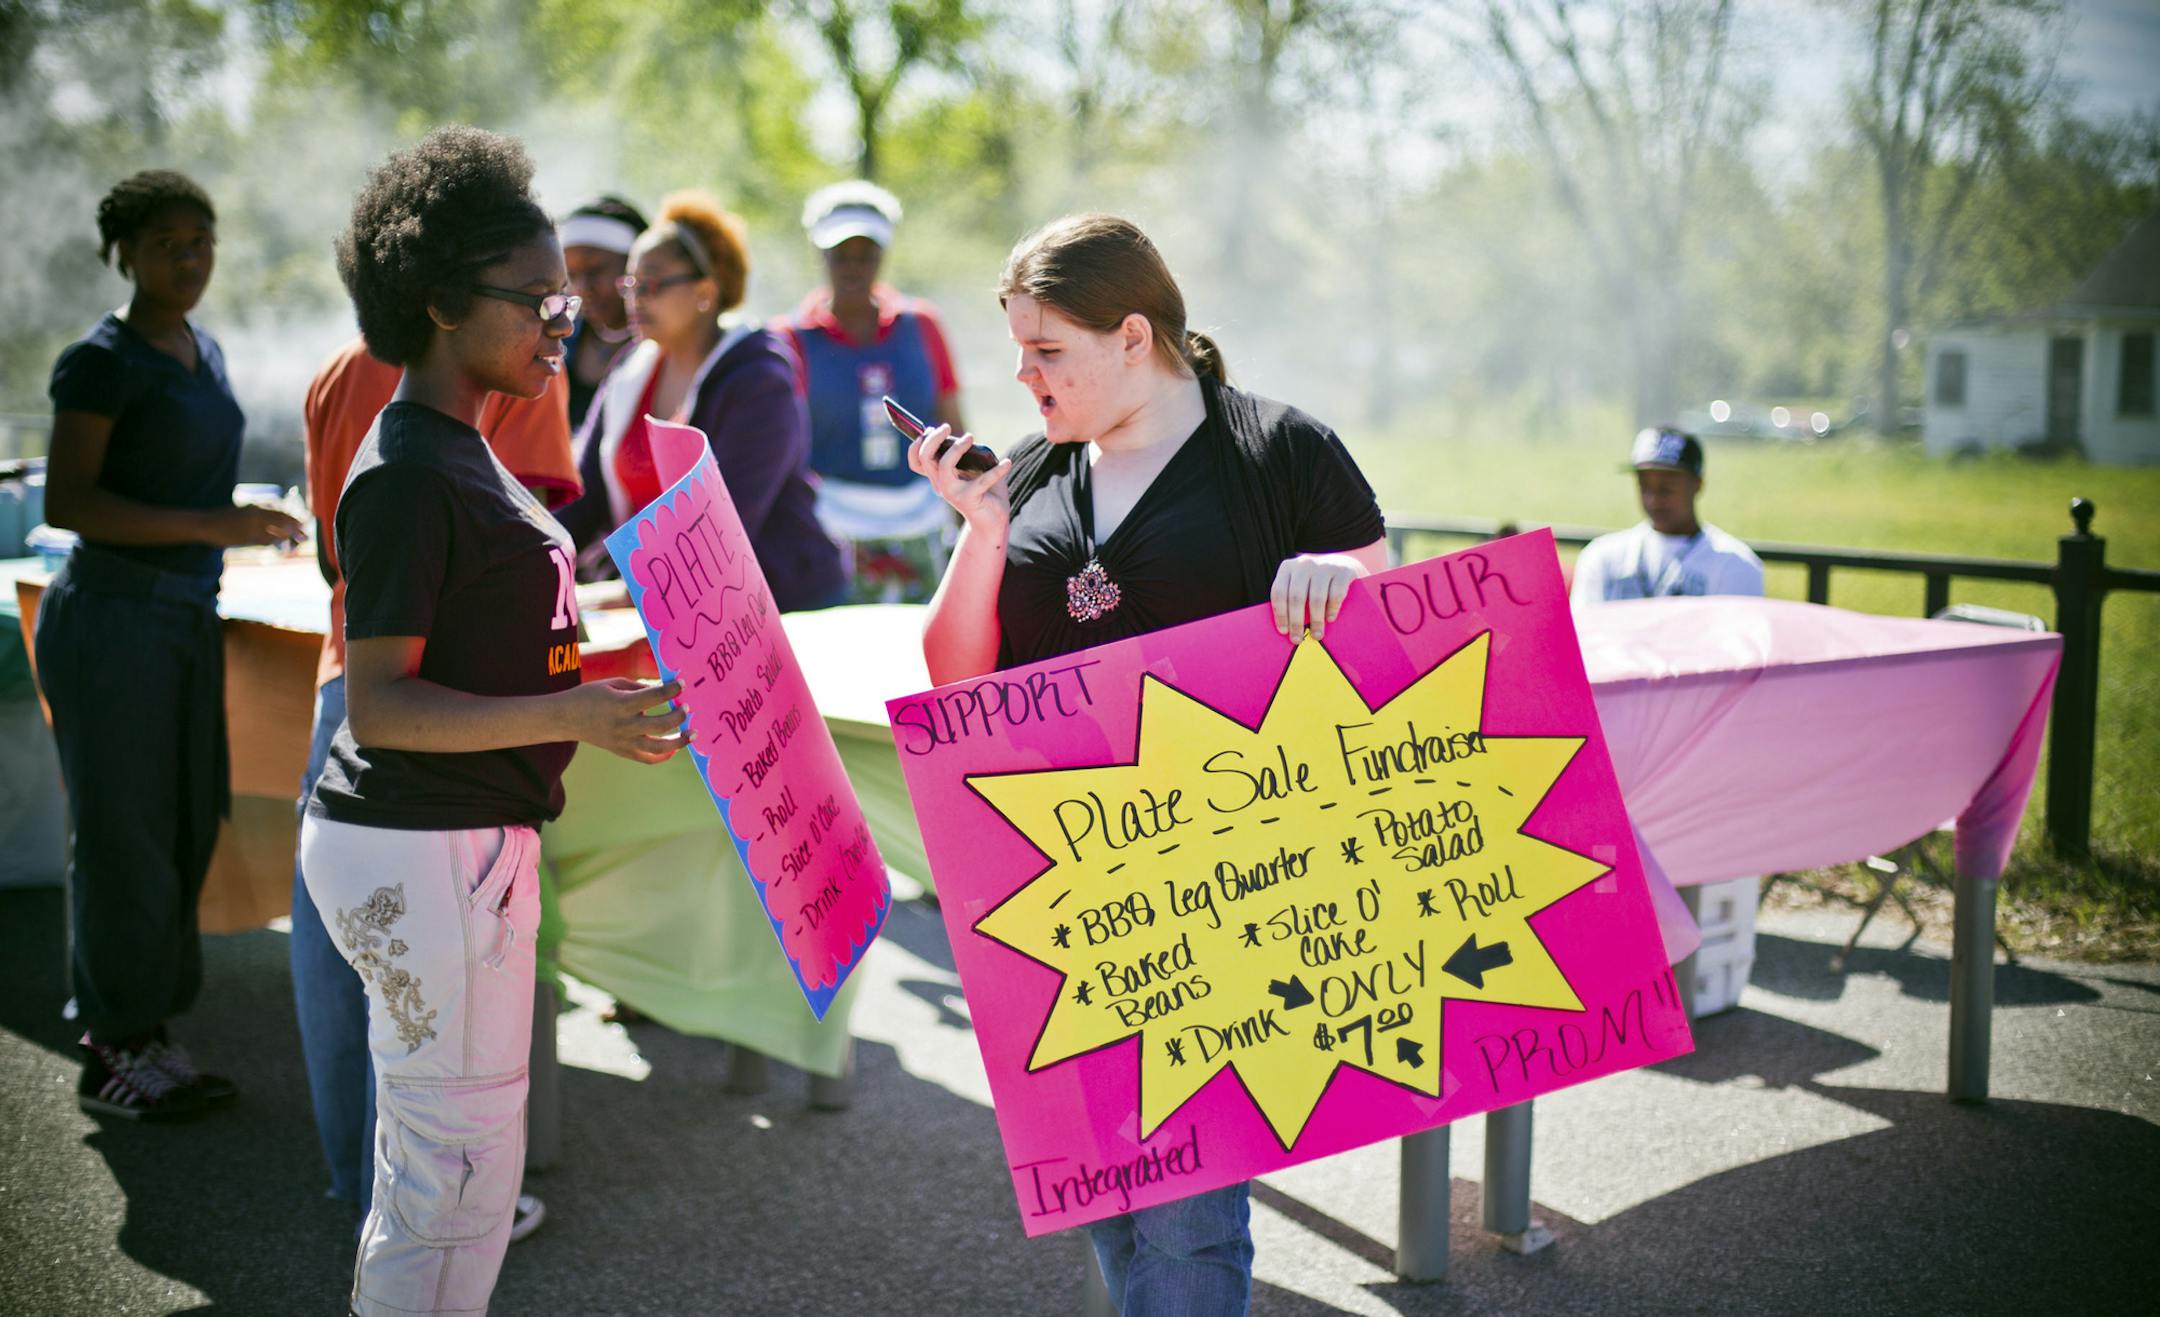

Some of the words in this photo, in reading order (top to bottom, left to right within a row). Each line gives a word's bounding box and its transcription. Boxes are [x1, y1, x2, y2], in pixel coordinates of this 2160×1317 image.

[647, 500, 735, 620] PLATE
[1380, 553, 1533, 635] OUR
[548, 642, 582, 675] ACAD
[895, 660, 1101, 755] SUPPORT
[762, 785, 798, 835] Roll
[1053, 788, 1194, 862] Plate
[1202, 745, 1319, 813] Sale
[1356, 800, 1474, 847] Potato
[1076, 891, 1156, 946] BBQ
[1214, 846, 1316, 902] Quarter
[1443, 864, 1526, 921] Roll
[1095, 932, 1197, 997] Baked
[1320, 939, 1425, 1018] ONLY
[1105, 974, 1212, 1028] Beans
[1180, 1008, 1291, 1063] Drink
[1013, 1124, 1204, 1216] Integrated
